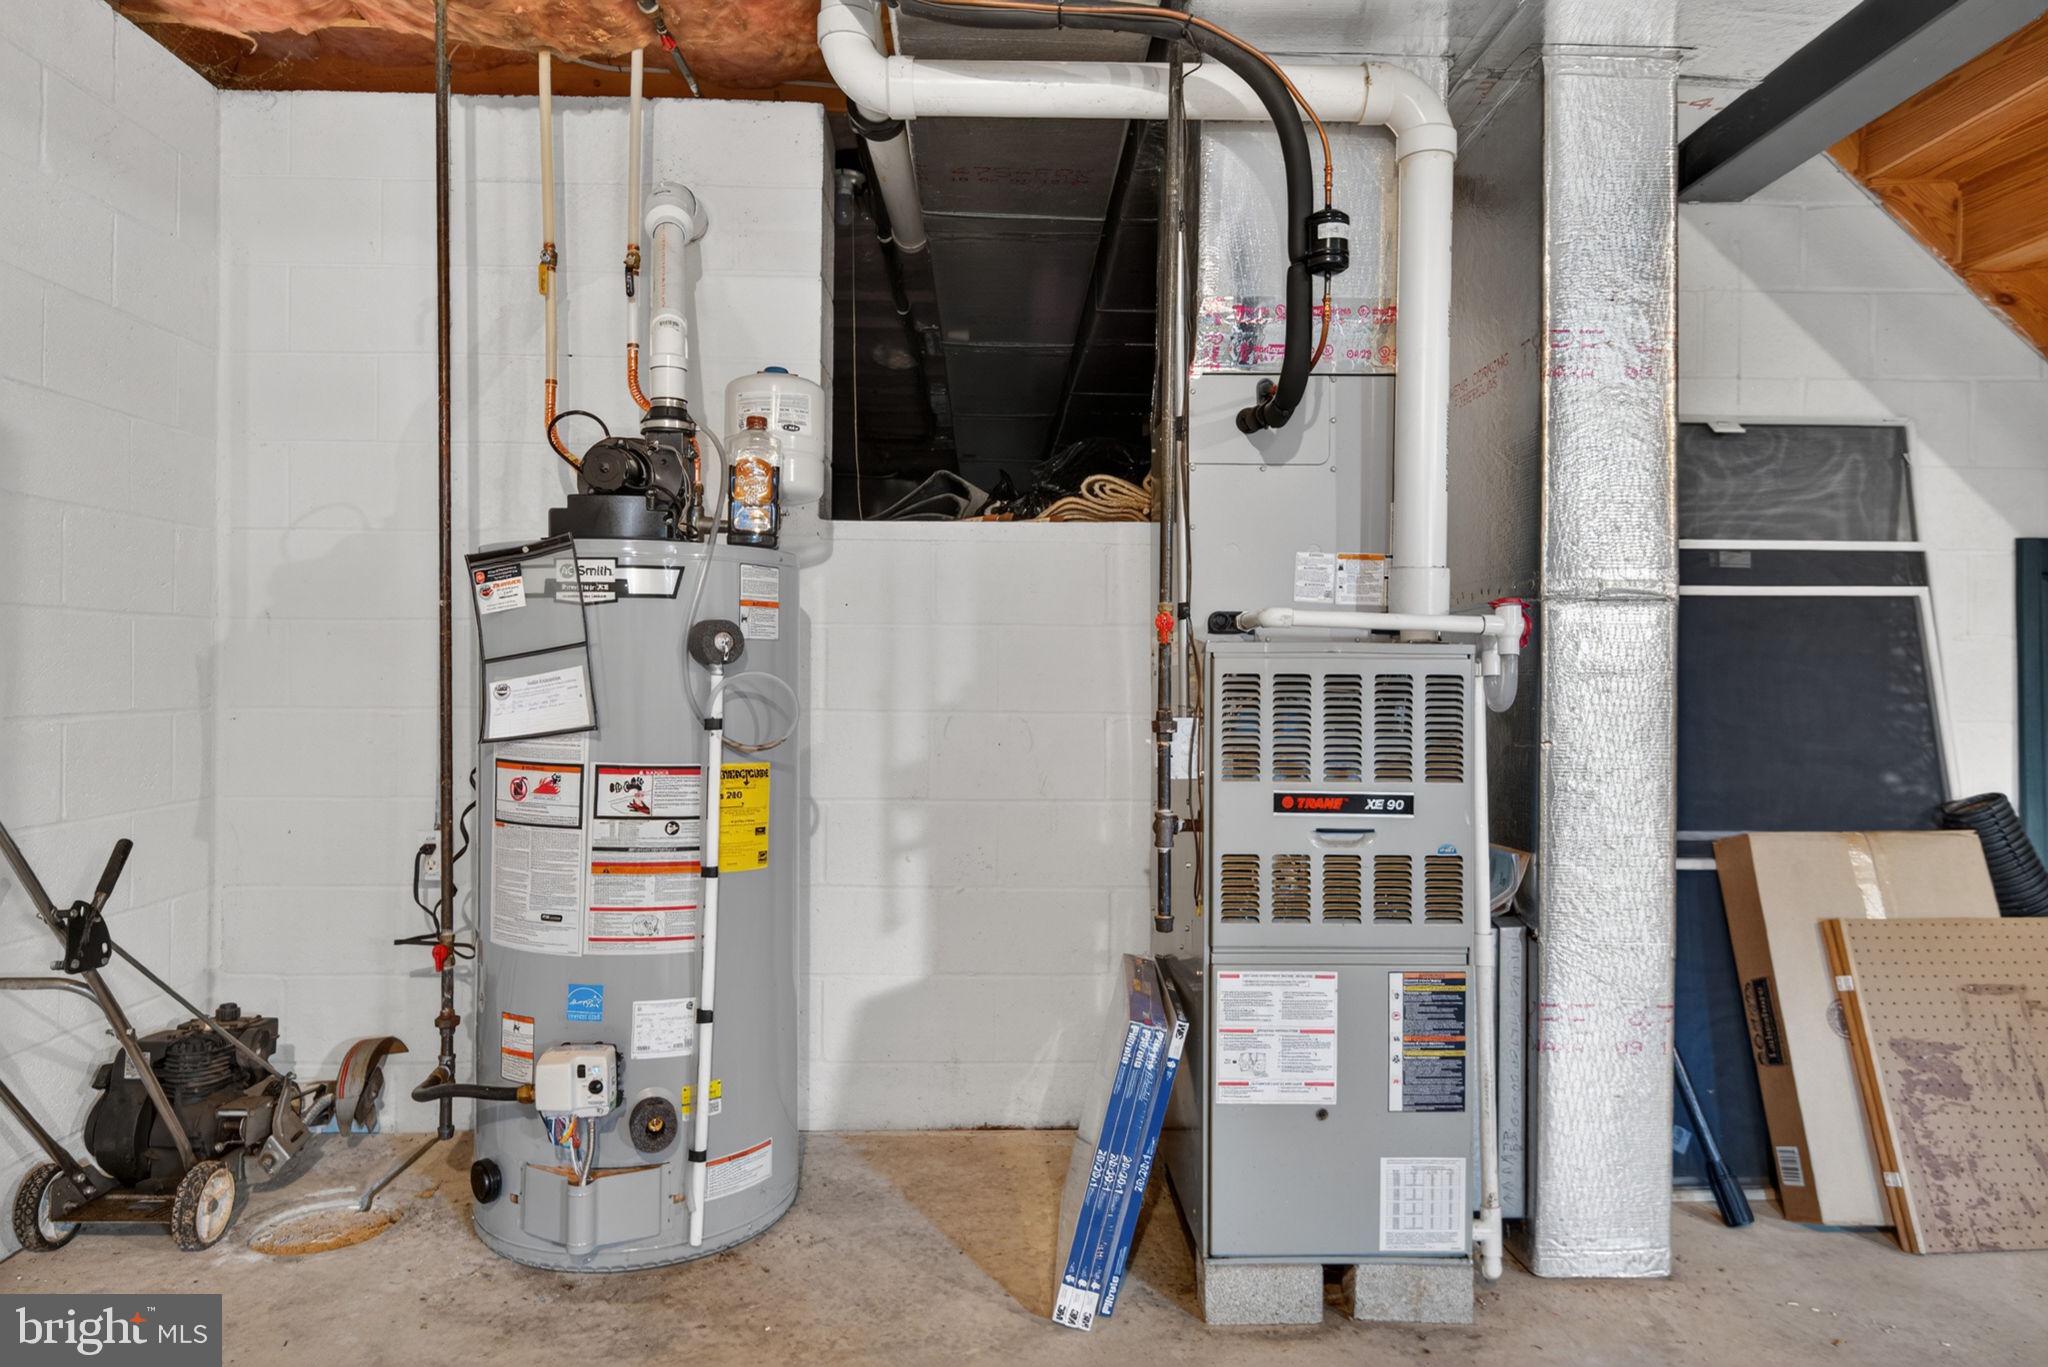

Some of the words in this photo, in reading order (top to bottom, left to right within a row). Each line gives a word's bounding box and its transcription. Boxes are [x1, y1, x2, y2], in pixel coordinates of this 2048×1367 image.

[578, 565, 612, 576] Smith
[1297, 797, 1344, 810] TRANE
[1364, 798, 1385, 810] XE
[1386, 799, 1405, 810] 90
